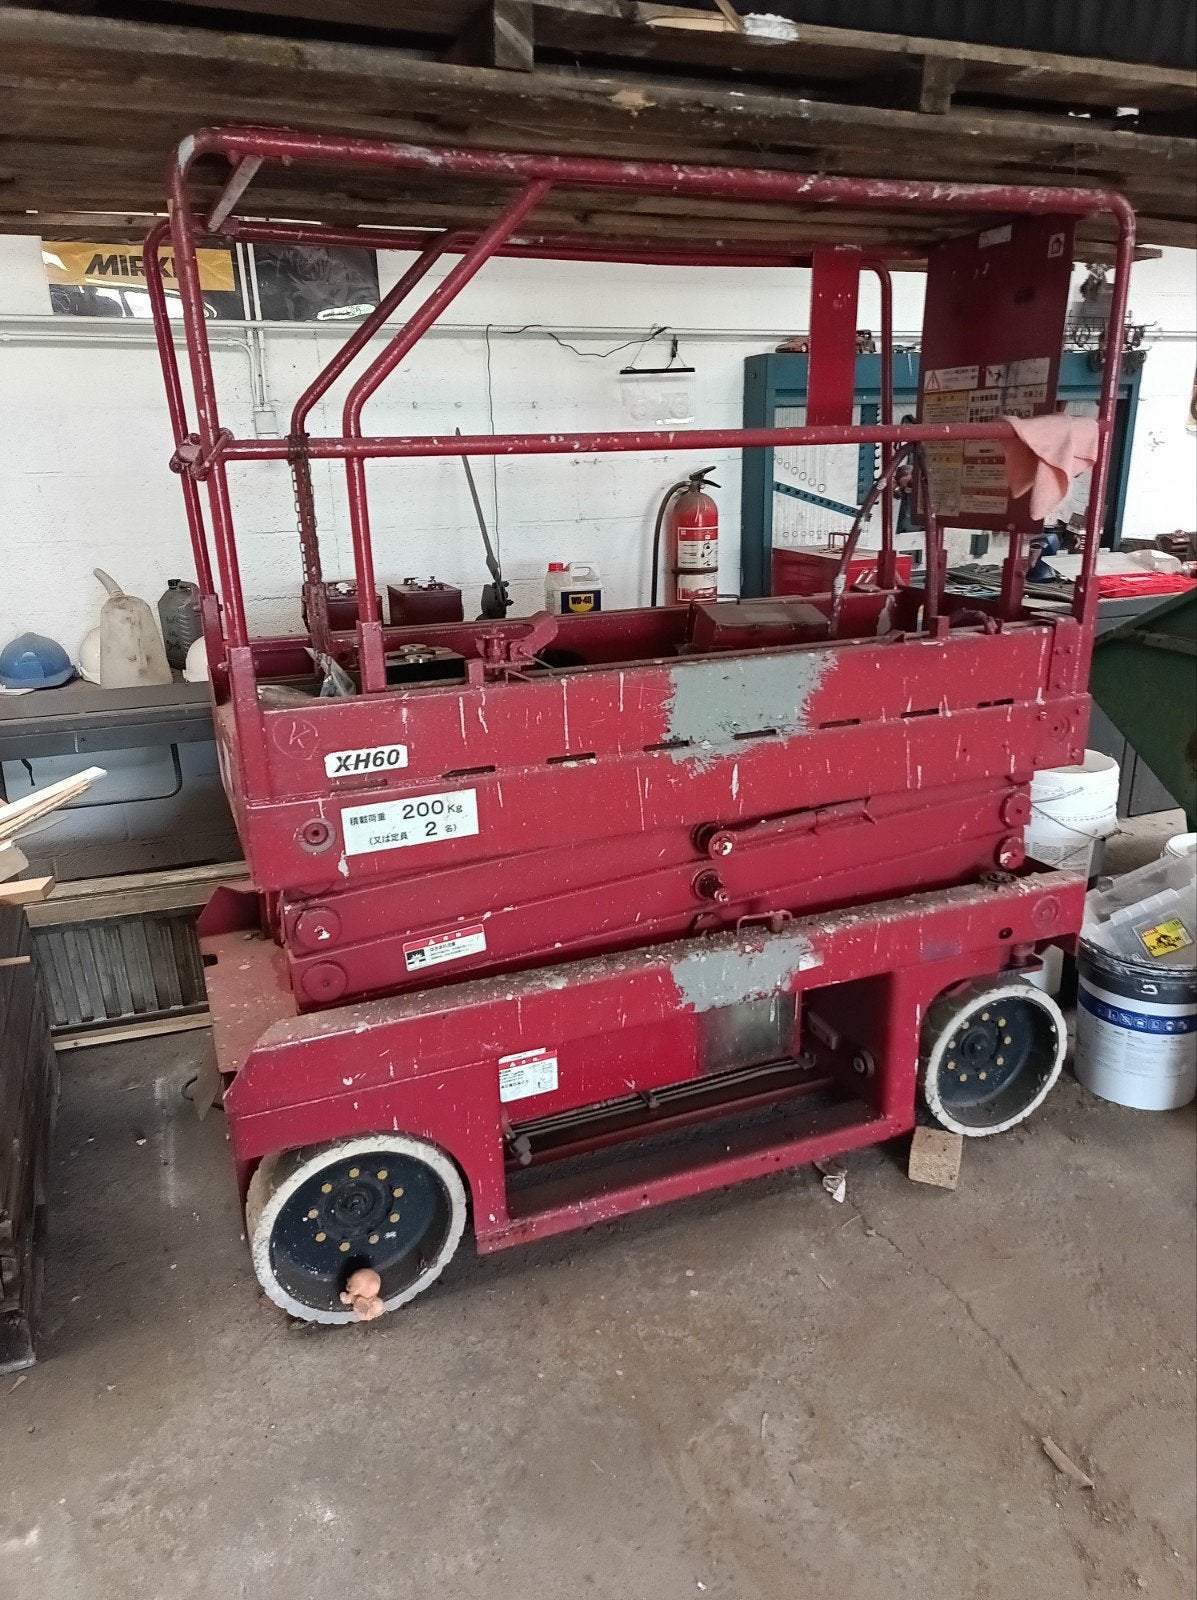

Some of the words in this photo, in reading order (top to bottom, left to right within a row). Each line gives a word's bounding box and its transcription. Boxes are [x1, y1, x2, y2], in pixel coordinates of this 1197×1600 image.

[85, 254, 178, 278] MIRK
[571, 595, 592, 605] WD-40
[334, 749, 400, 773] XH60
[402, 800, 444, 819] 200
[425, 821, 438, 836] 2
